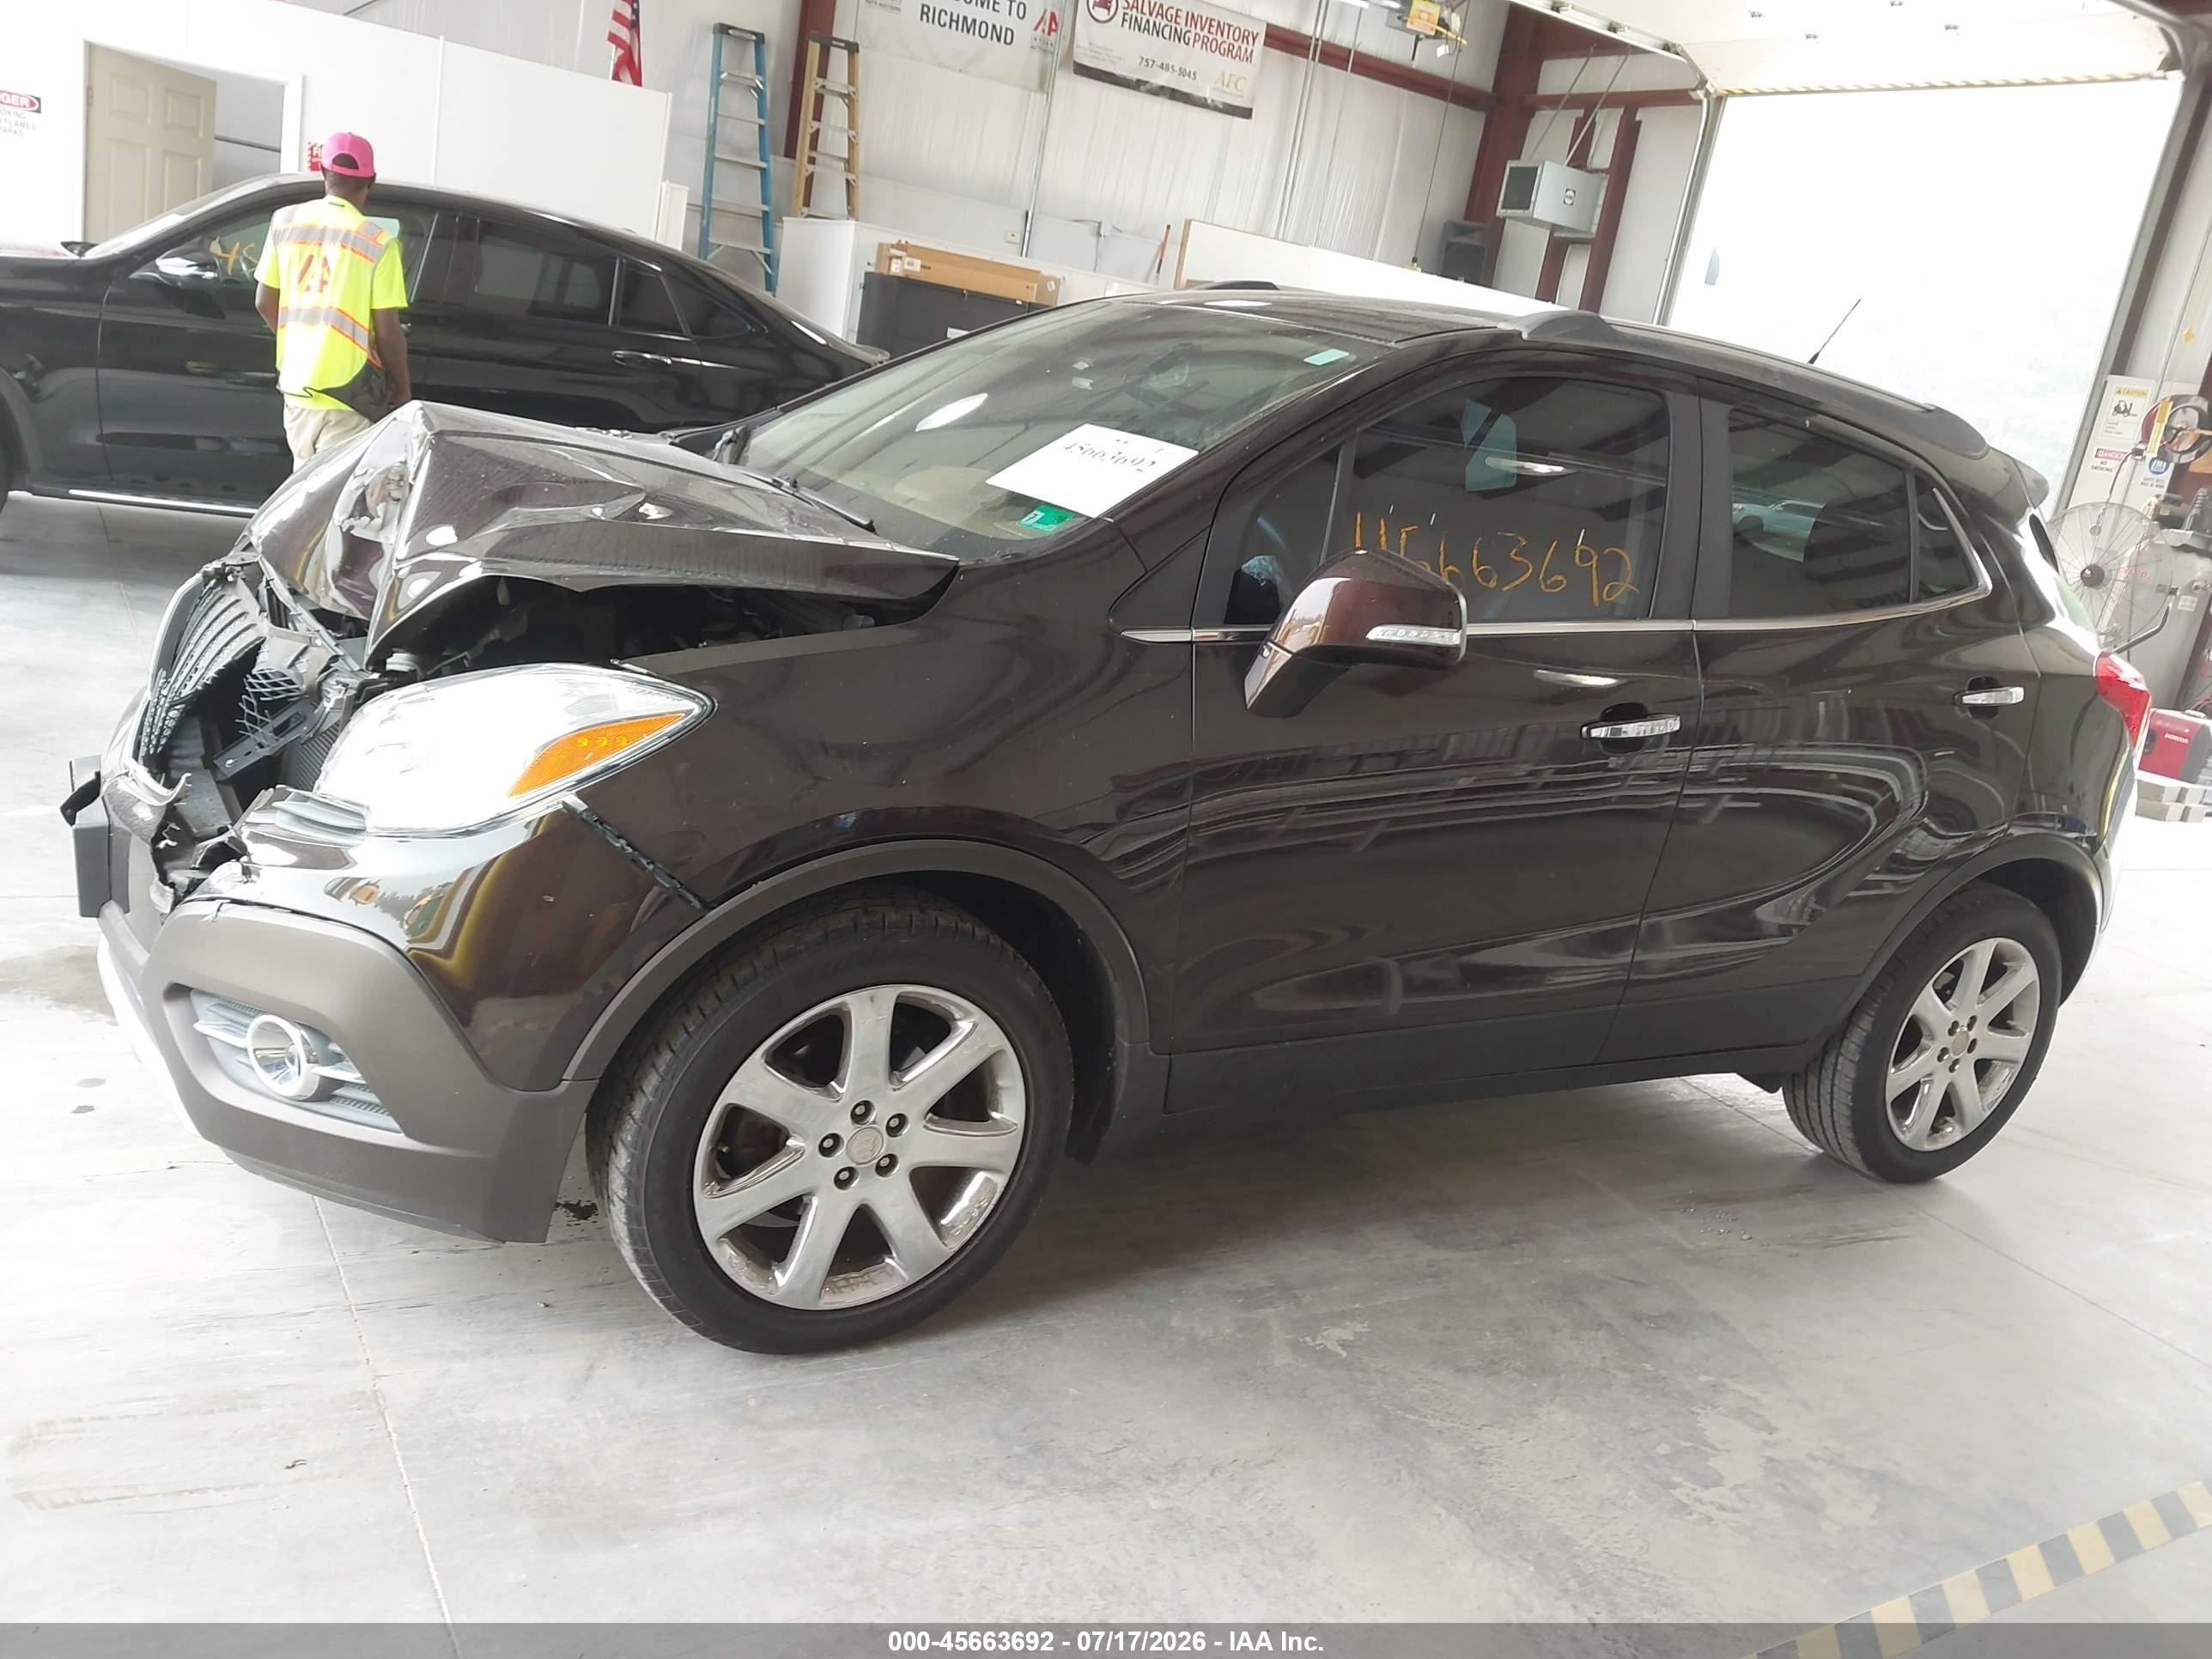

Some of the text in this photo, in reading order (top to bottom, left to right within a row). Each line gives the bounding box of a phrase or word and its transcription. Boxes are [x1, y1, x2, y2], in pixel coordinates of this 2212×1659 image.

[920, 3, 1014, 46] RICHMOND
[1007, 0, 1026, 20] TO
[1122, 0, 1259, 46] SALVAGE INVENTORY
[1121, 12, 1254, 64] FINANCING PROGRAM
[1214, 71, 1247, 92] AFC
[2121, 388, 2148, 397] CAUTION
